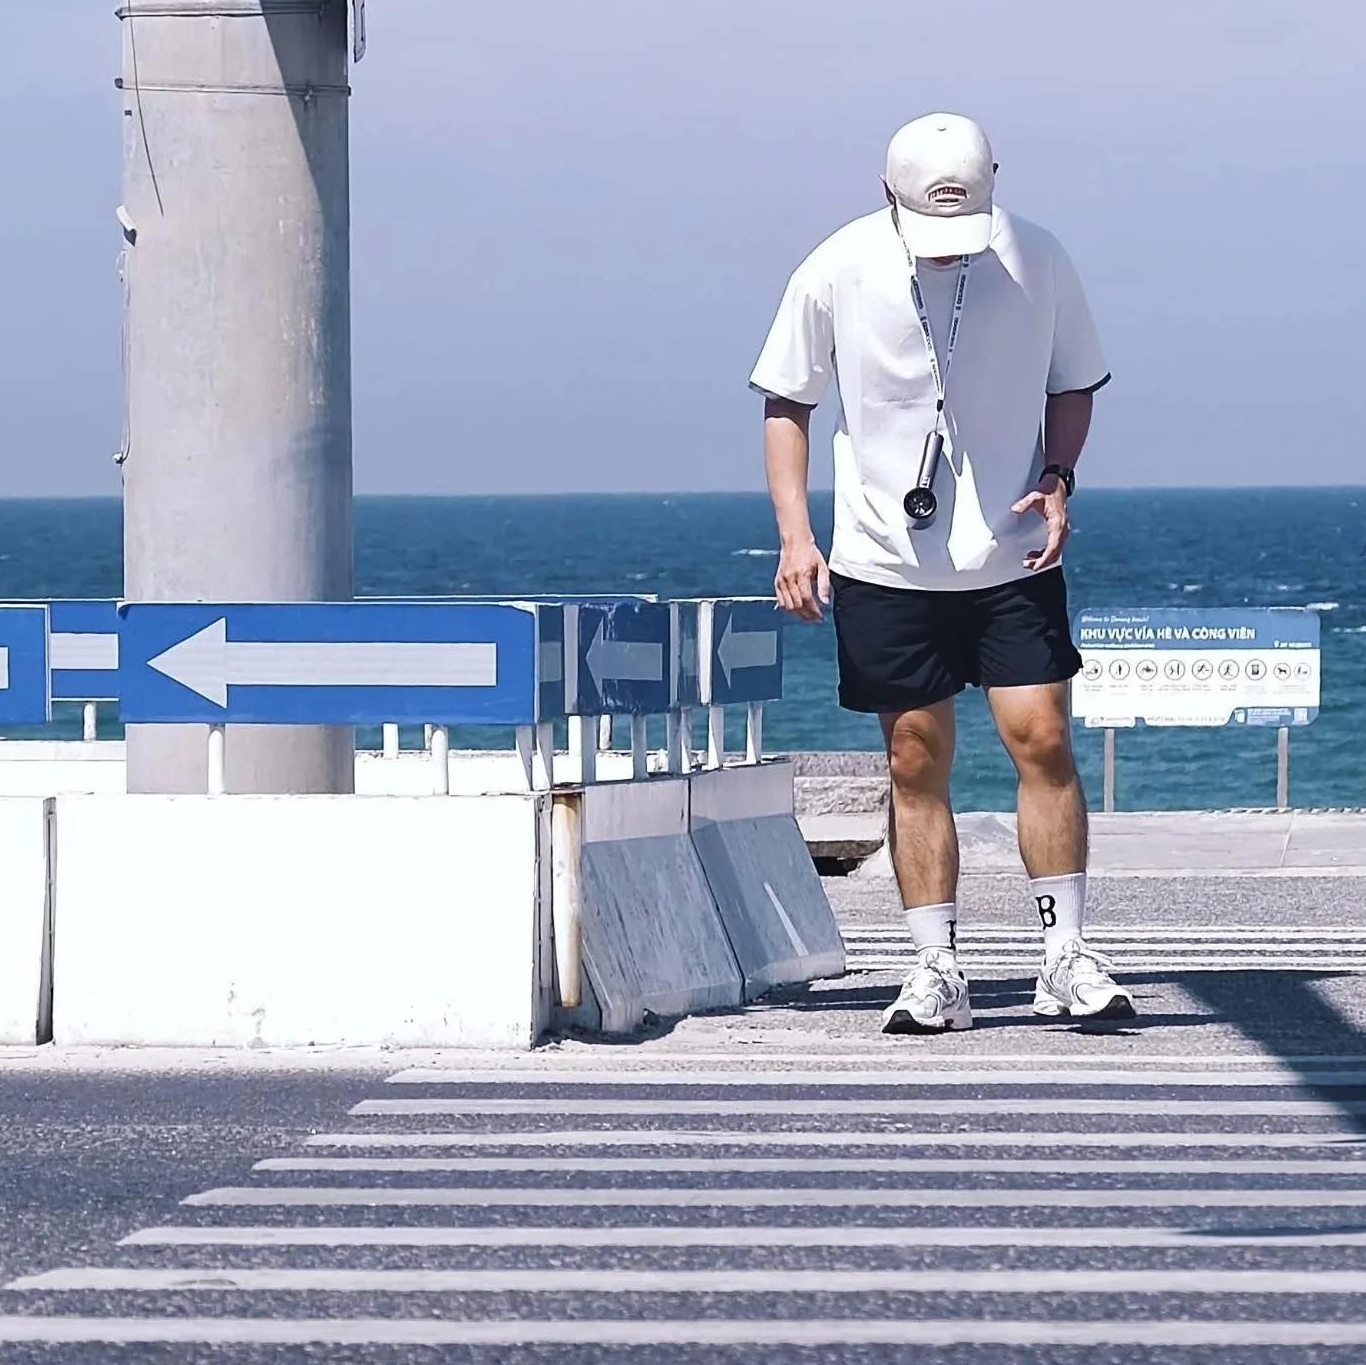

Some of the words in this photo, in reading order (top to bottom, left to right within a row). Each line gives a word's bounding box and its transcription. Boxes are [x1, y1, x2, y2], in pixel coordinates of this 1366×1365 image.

[1081, 628, 1106, 640] KHU
[1108, 627, 1133, 642] VỰC
[1192, 626, 1226, 640] CÔNG
[1227, 626, 1256, 640] VIÊN
[1035, 894, 1057, 931] B
